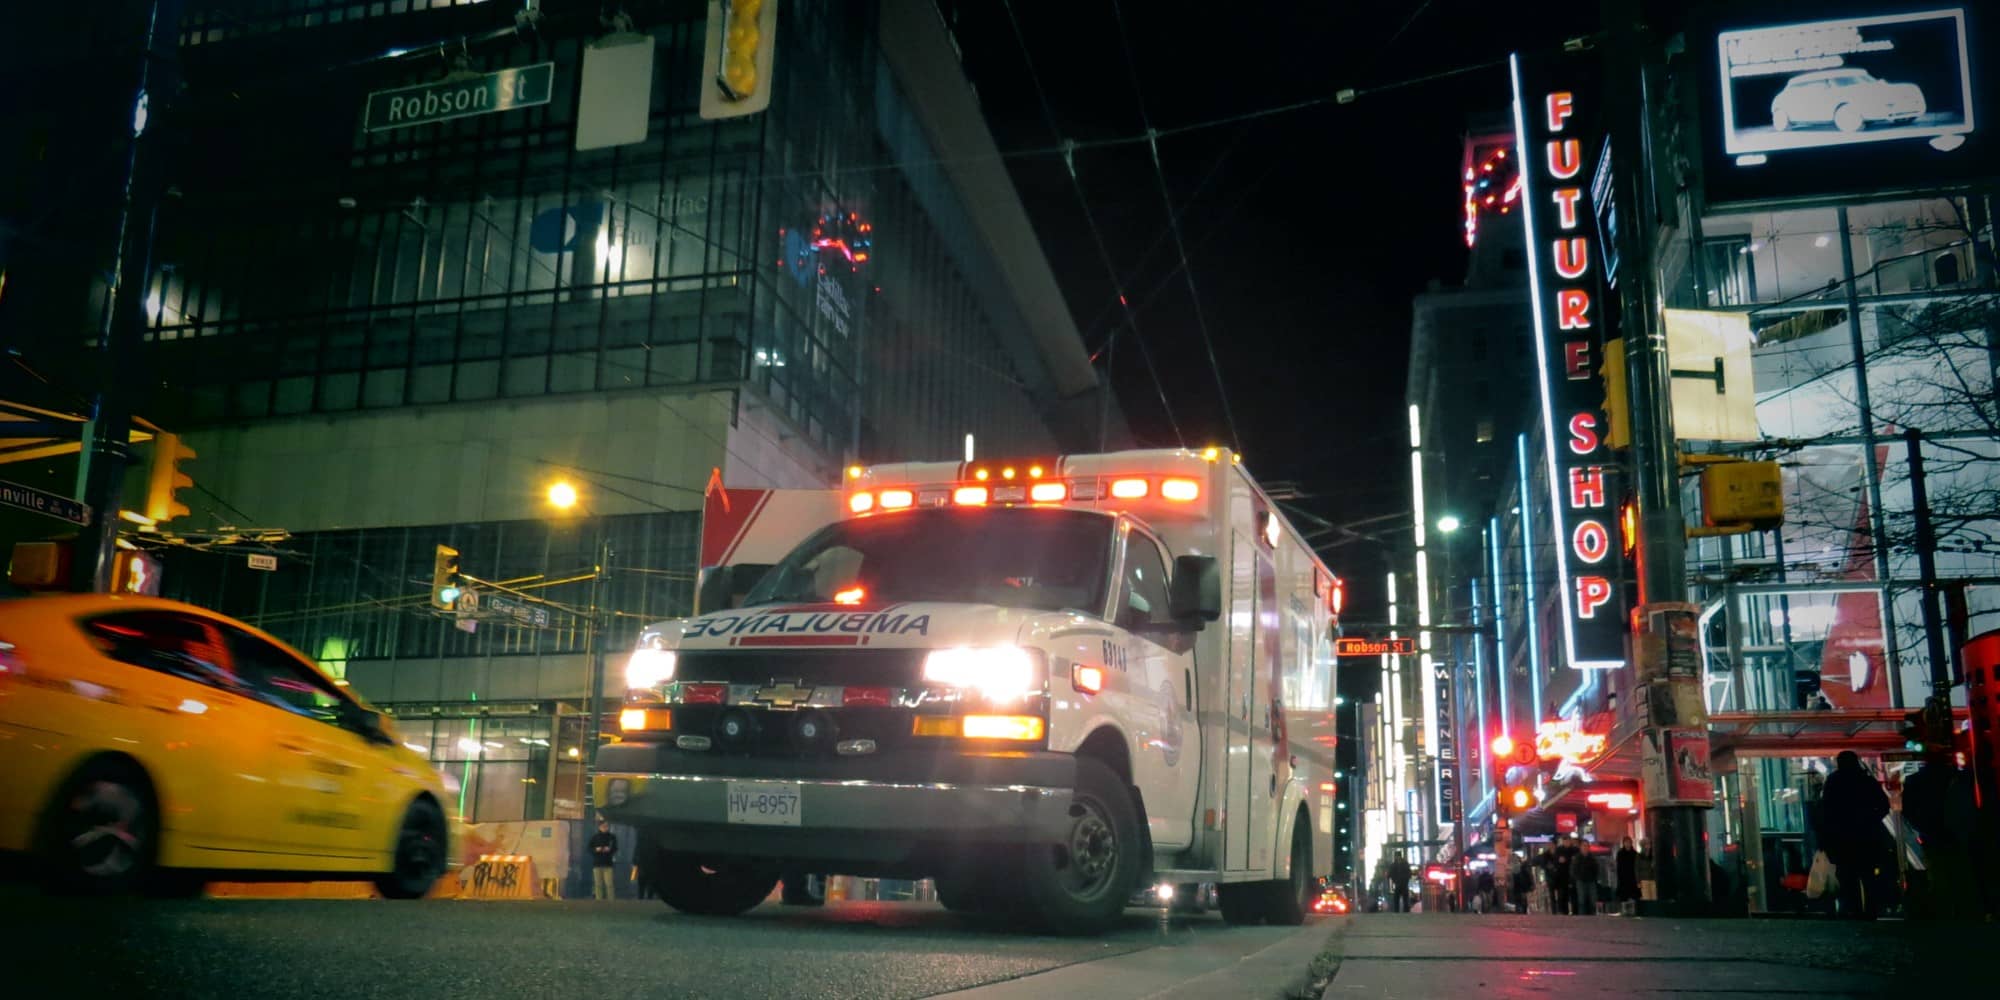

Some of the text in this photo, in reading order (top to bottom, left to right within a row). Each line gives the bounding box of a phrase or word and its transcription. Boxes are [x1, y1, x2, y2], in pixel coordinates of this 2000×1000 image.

[389, 74, 527, 121] Robson St
[1545, 91, 1611, 619] FUTURE SHOP
[0, 486, 45, 510] nville
[1346, 641, 1404, 653] Robson St
[1434, 668, 1454, 800] WINNERS
